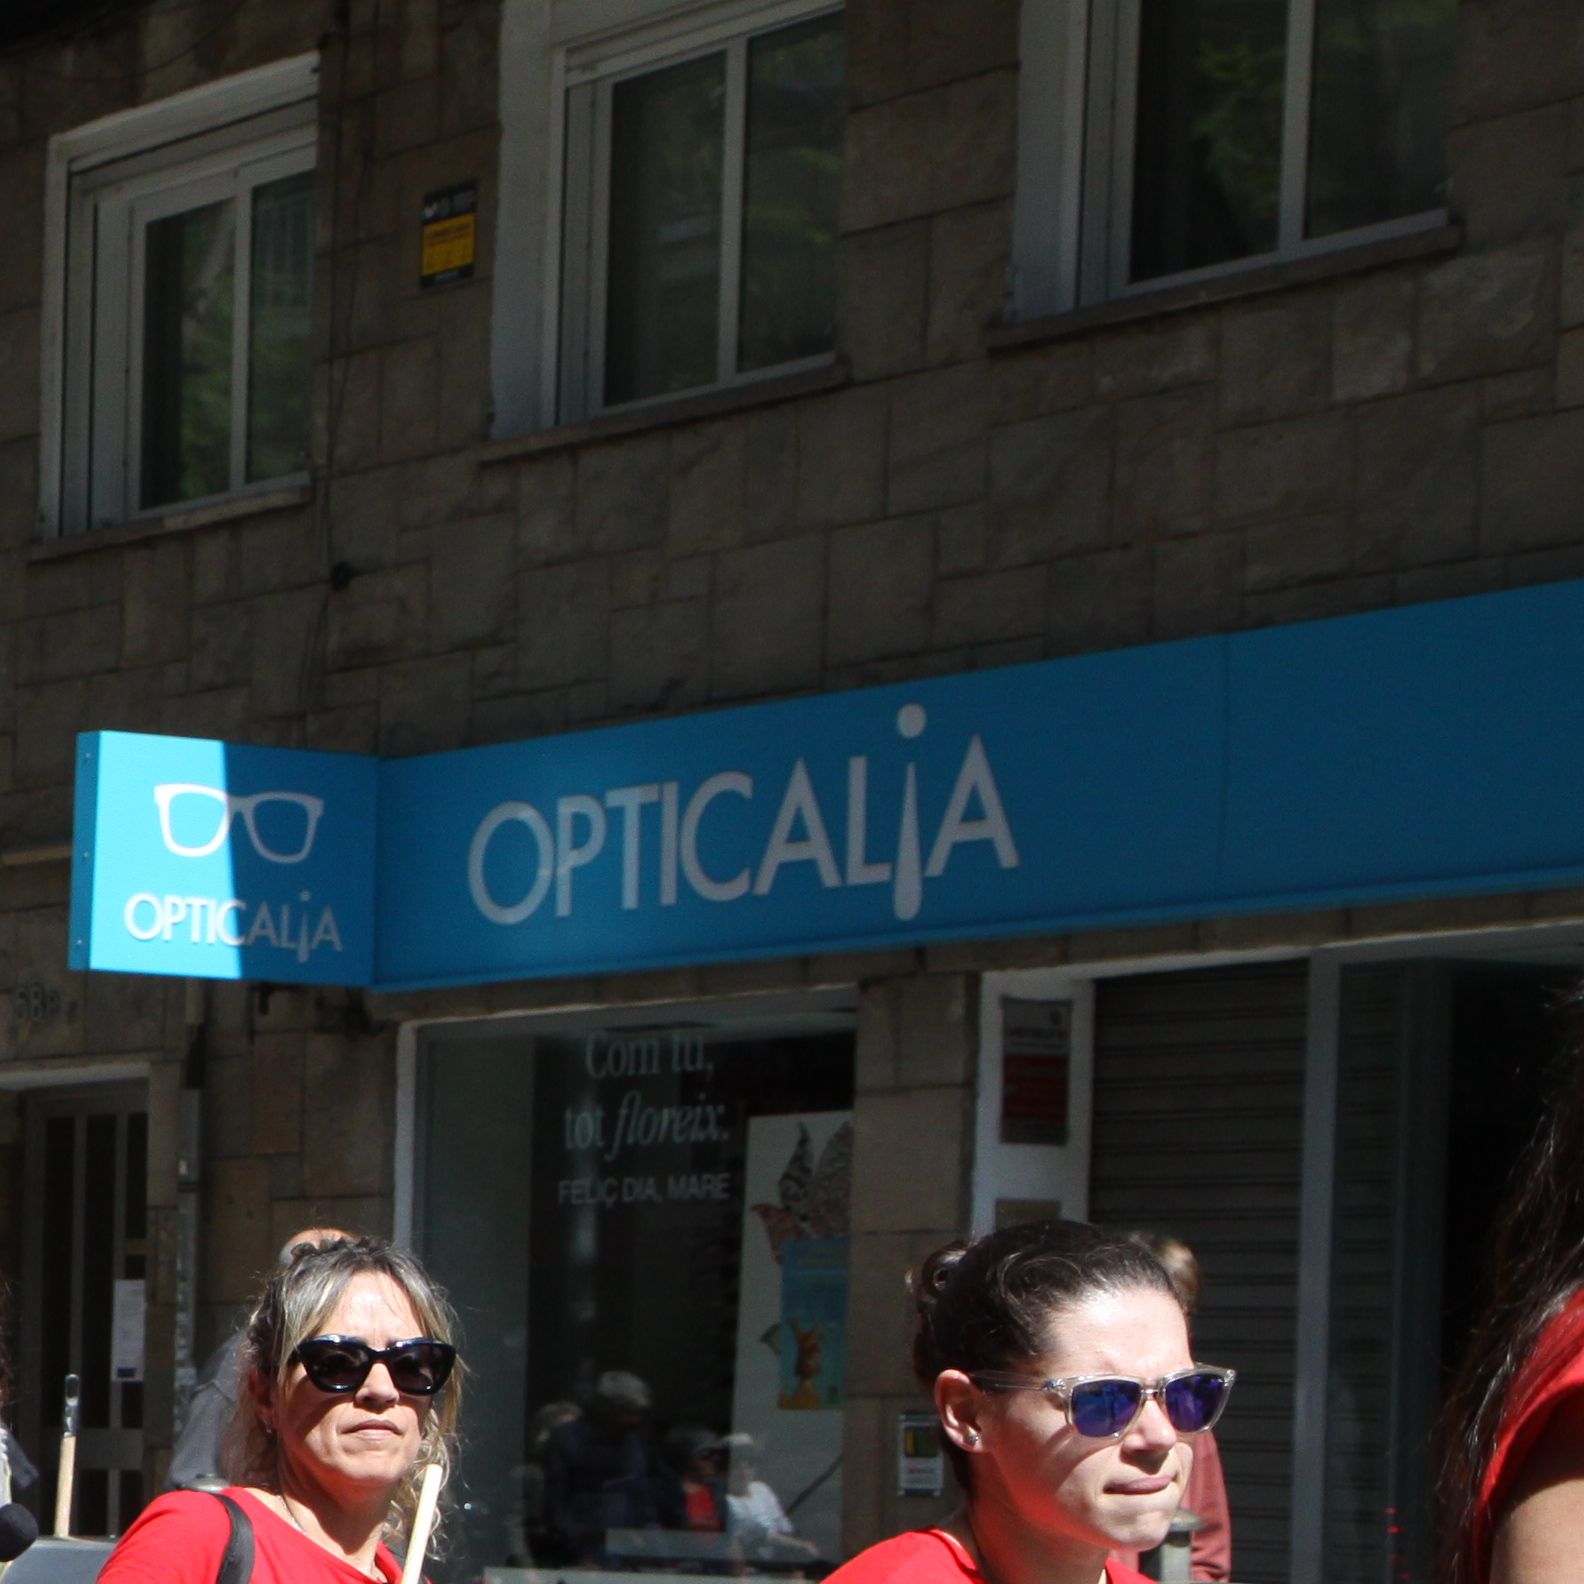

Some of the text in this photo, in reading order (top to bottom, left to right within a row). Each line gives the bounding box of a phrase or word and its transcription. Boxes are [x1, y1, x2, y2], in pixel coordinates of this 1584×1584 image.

[585, 1030, 661, 1079] Com
[563, 1089, 730, 1162] tot floreix.
[557, 1172, 732, 1210] FELIÇ DIA, MARE
